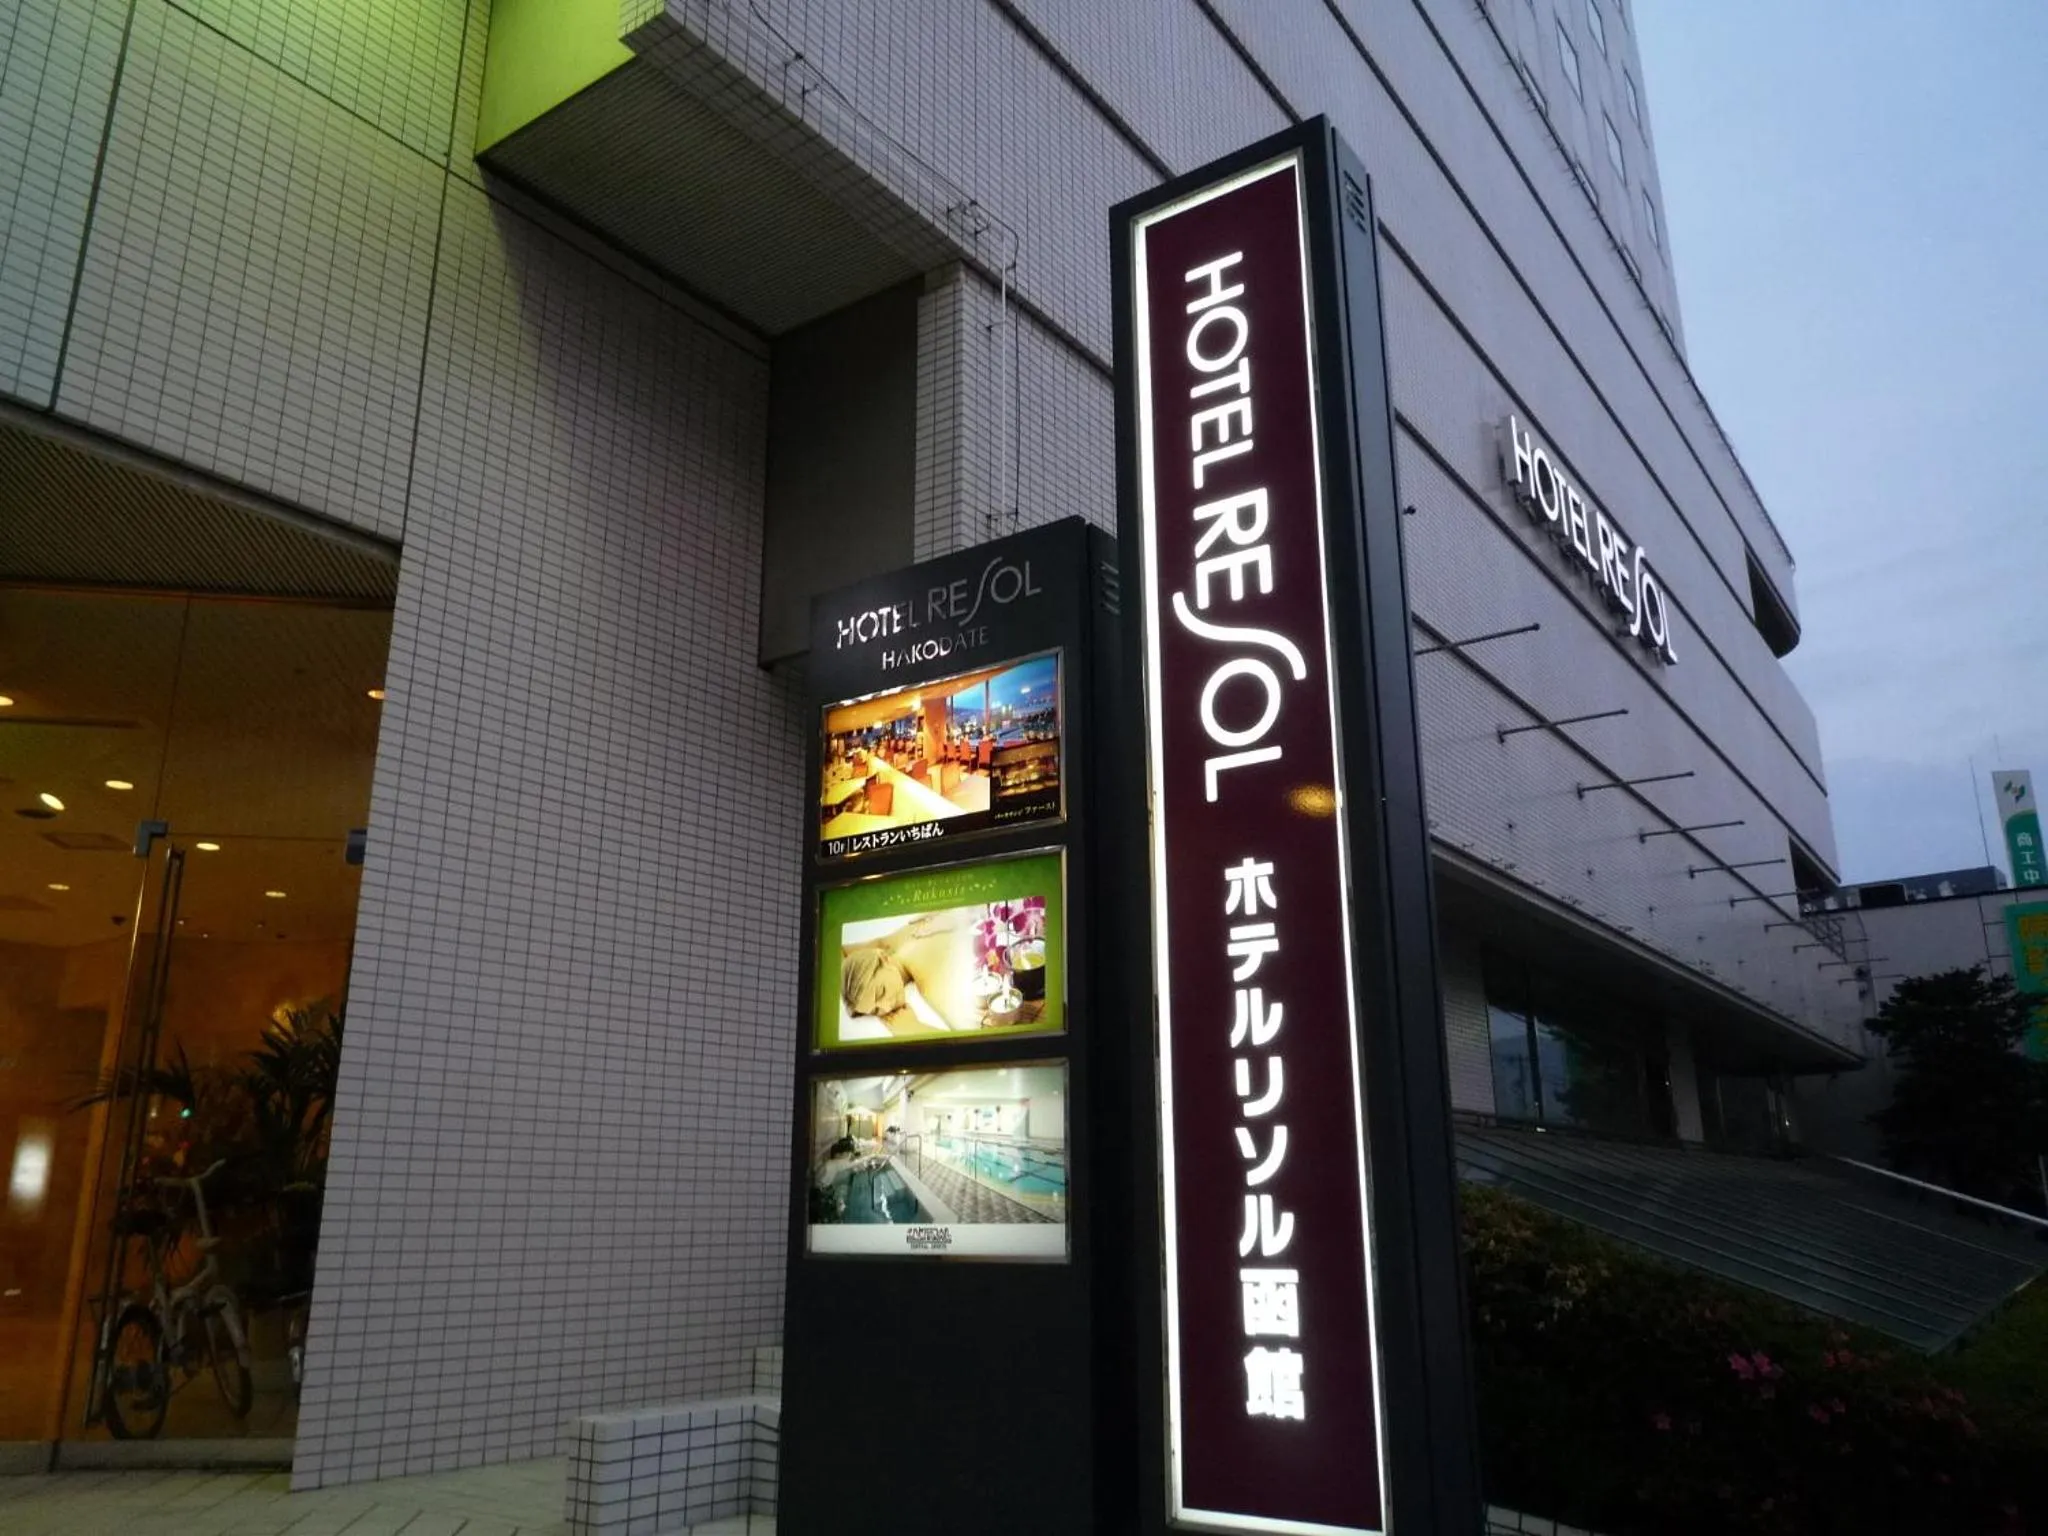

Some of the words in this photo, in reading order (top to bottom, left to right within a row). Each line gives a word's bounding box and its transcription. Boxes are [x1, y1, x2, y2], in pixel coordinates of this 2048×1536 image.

[1184, 250, 1254, 490] HOTEL
[836, 599, 922, 650] HOTEL
[927, 556, 1043, 626] RESOL
[882, 625, 990, 671] HAKODATE
[1172, 486, 1307, 803] RESOL
[1510, 414, 1600, 572] HOTEL
[1596, 510, 1679, 664] RESOL
[852, 821, 945, 852] レストランいちばん
[1223, 856, 1306, 1422] ホテルリソル函館
